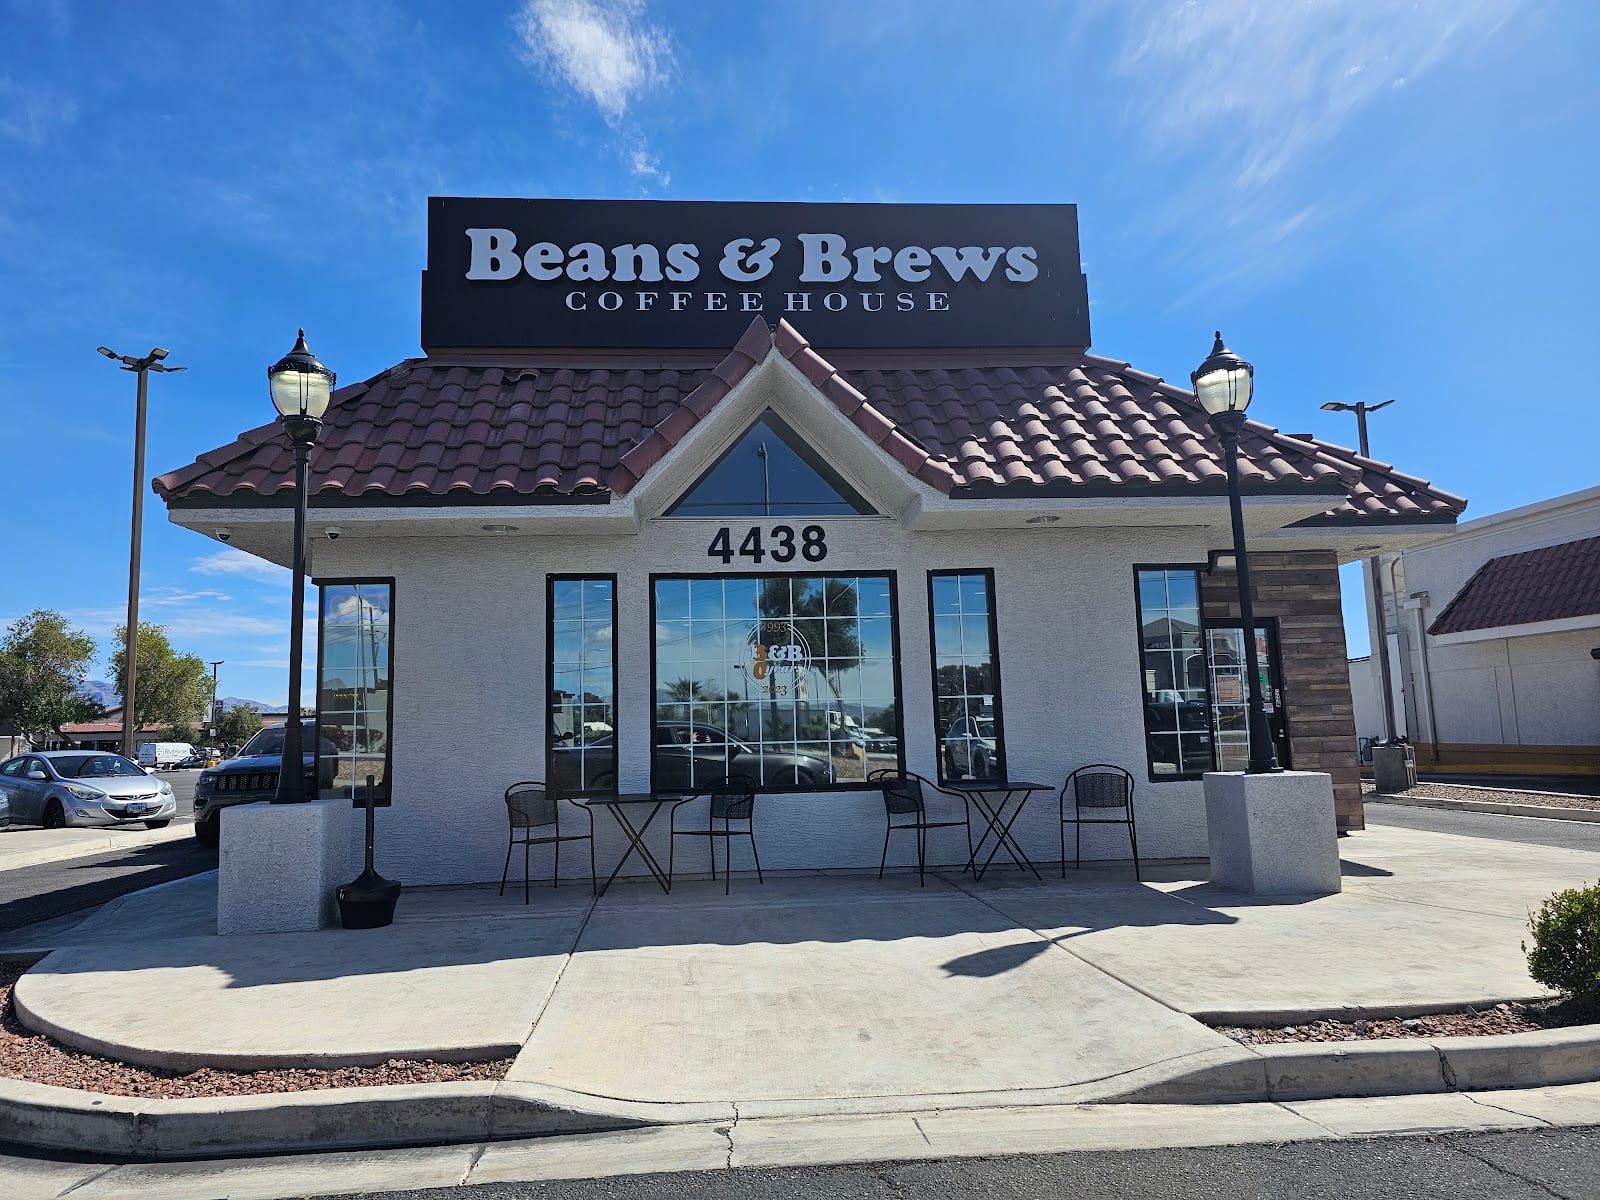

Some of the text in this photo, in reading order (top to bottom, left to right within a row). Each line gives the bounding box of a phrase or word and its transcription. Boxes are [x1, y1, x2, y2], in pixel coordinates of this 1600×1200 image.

[465, 228, 1039, 283] Beans & Brews
[565, 291, 950, 312] COFFEE HOUSE
[707, 525, 828, 564] 4438
